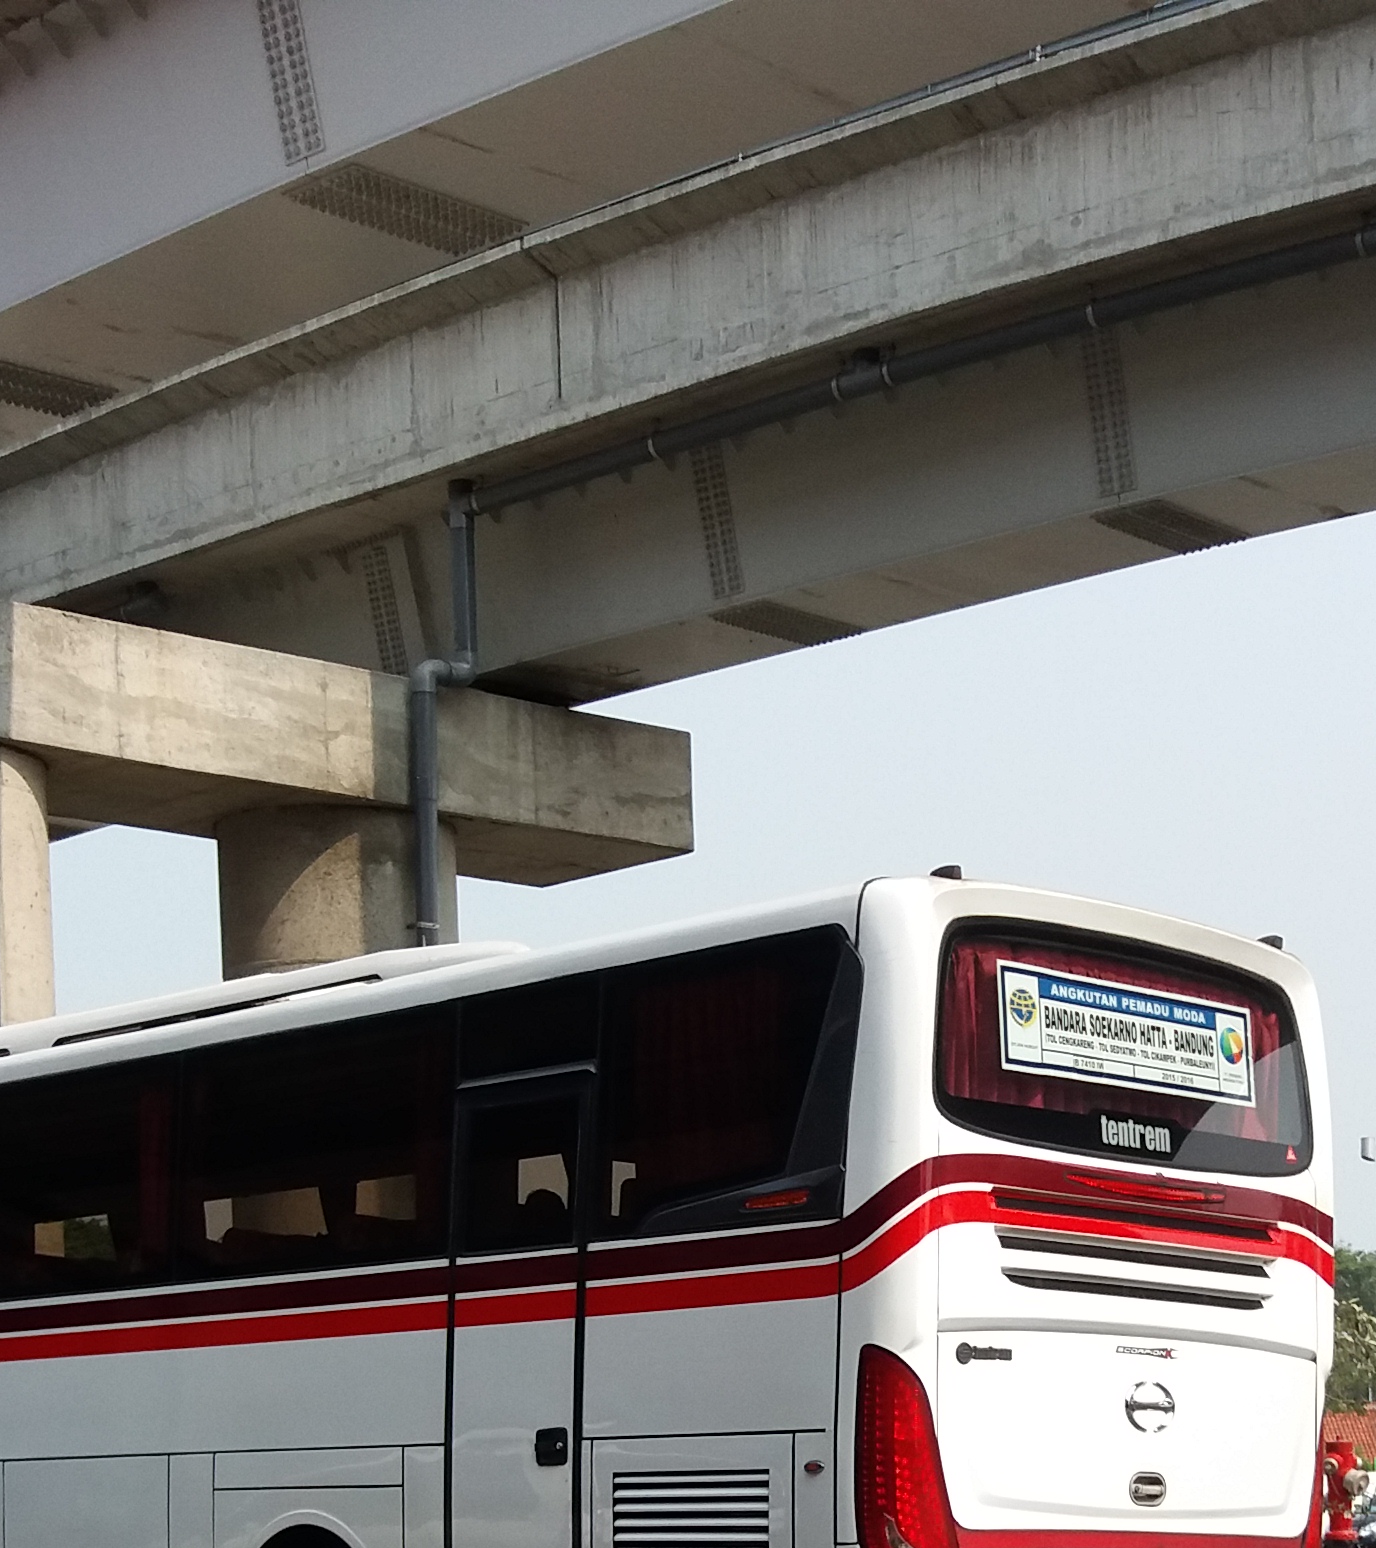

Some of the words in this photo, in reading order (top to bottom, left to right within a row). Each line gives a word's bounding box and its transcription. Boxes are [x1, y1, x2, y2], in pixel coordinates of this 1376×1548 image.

[1050, 983, 1117, 1009] ANGKUTAN
[1122, 997, 1170, 1017] PEMADU
[1173, 1007, 1207, 1025] MODA
[1044, 1005, 1088, 1036] BANDARA
[1089, 1013, 1137, 1044] SOEKARNO
[1139, 1022, 1168, 1050] HATTA
[1173, 1029, 1215, 1058] BANDUNG
[1058, 1035, 1095, 1050] CENGKARENG
[1098, 1042, 1109, 1053] TOL
[1140, 1049, 1151, 1060] TOL
[1151, 1050, 1177, 1064] CIKAMPEK
[1161, 1072, 1176, 1082] 2015
[1180, 1074, 1194, 1085] 2016
[1100, 1114, 1171, 1154] tentrem
